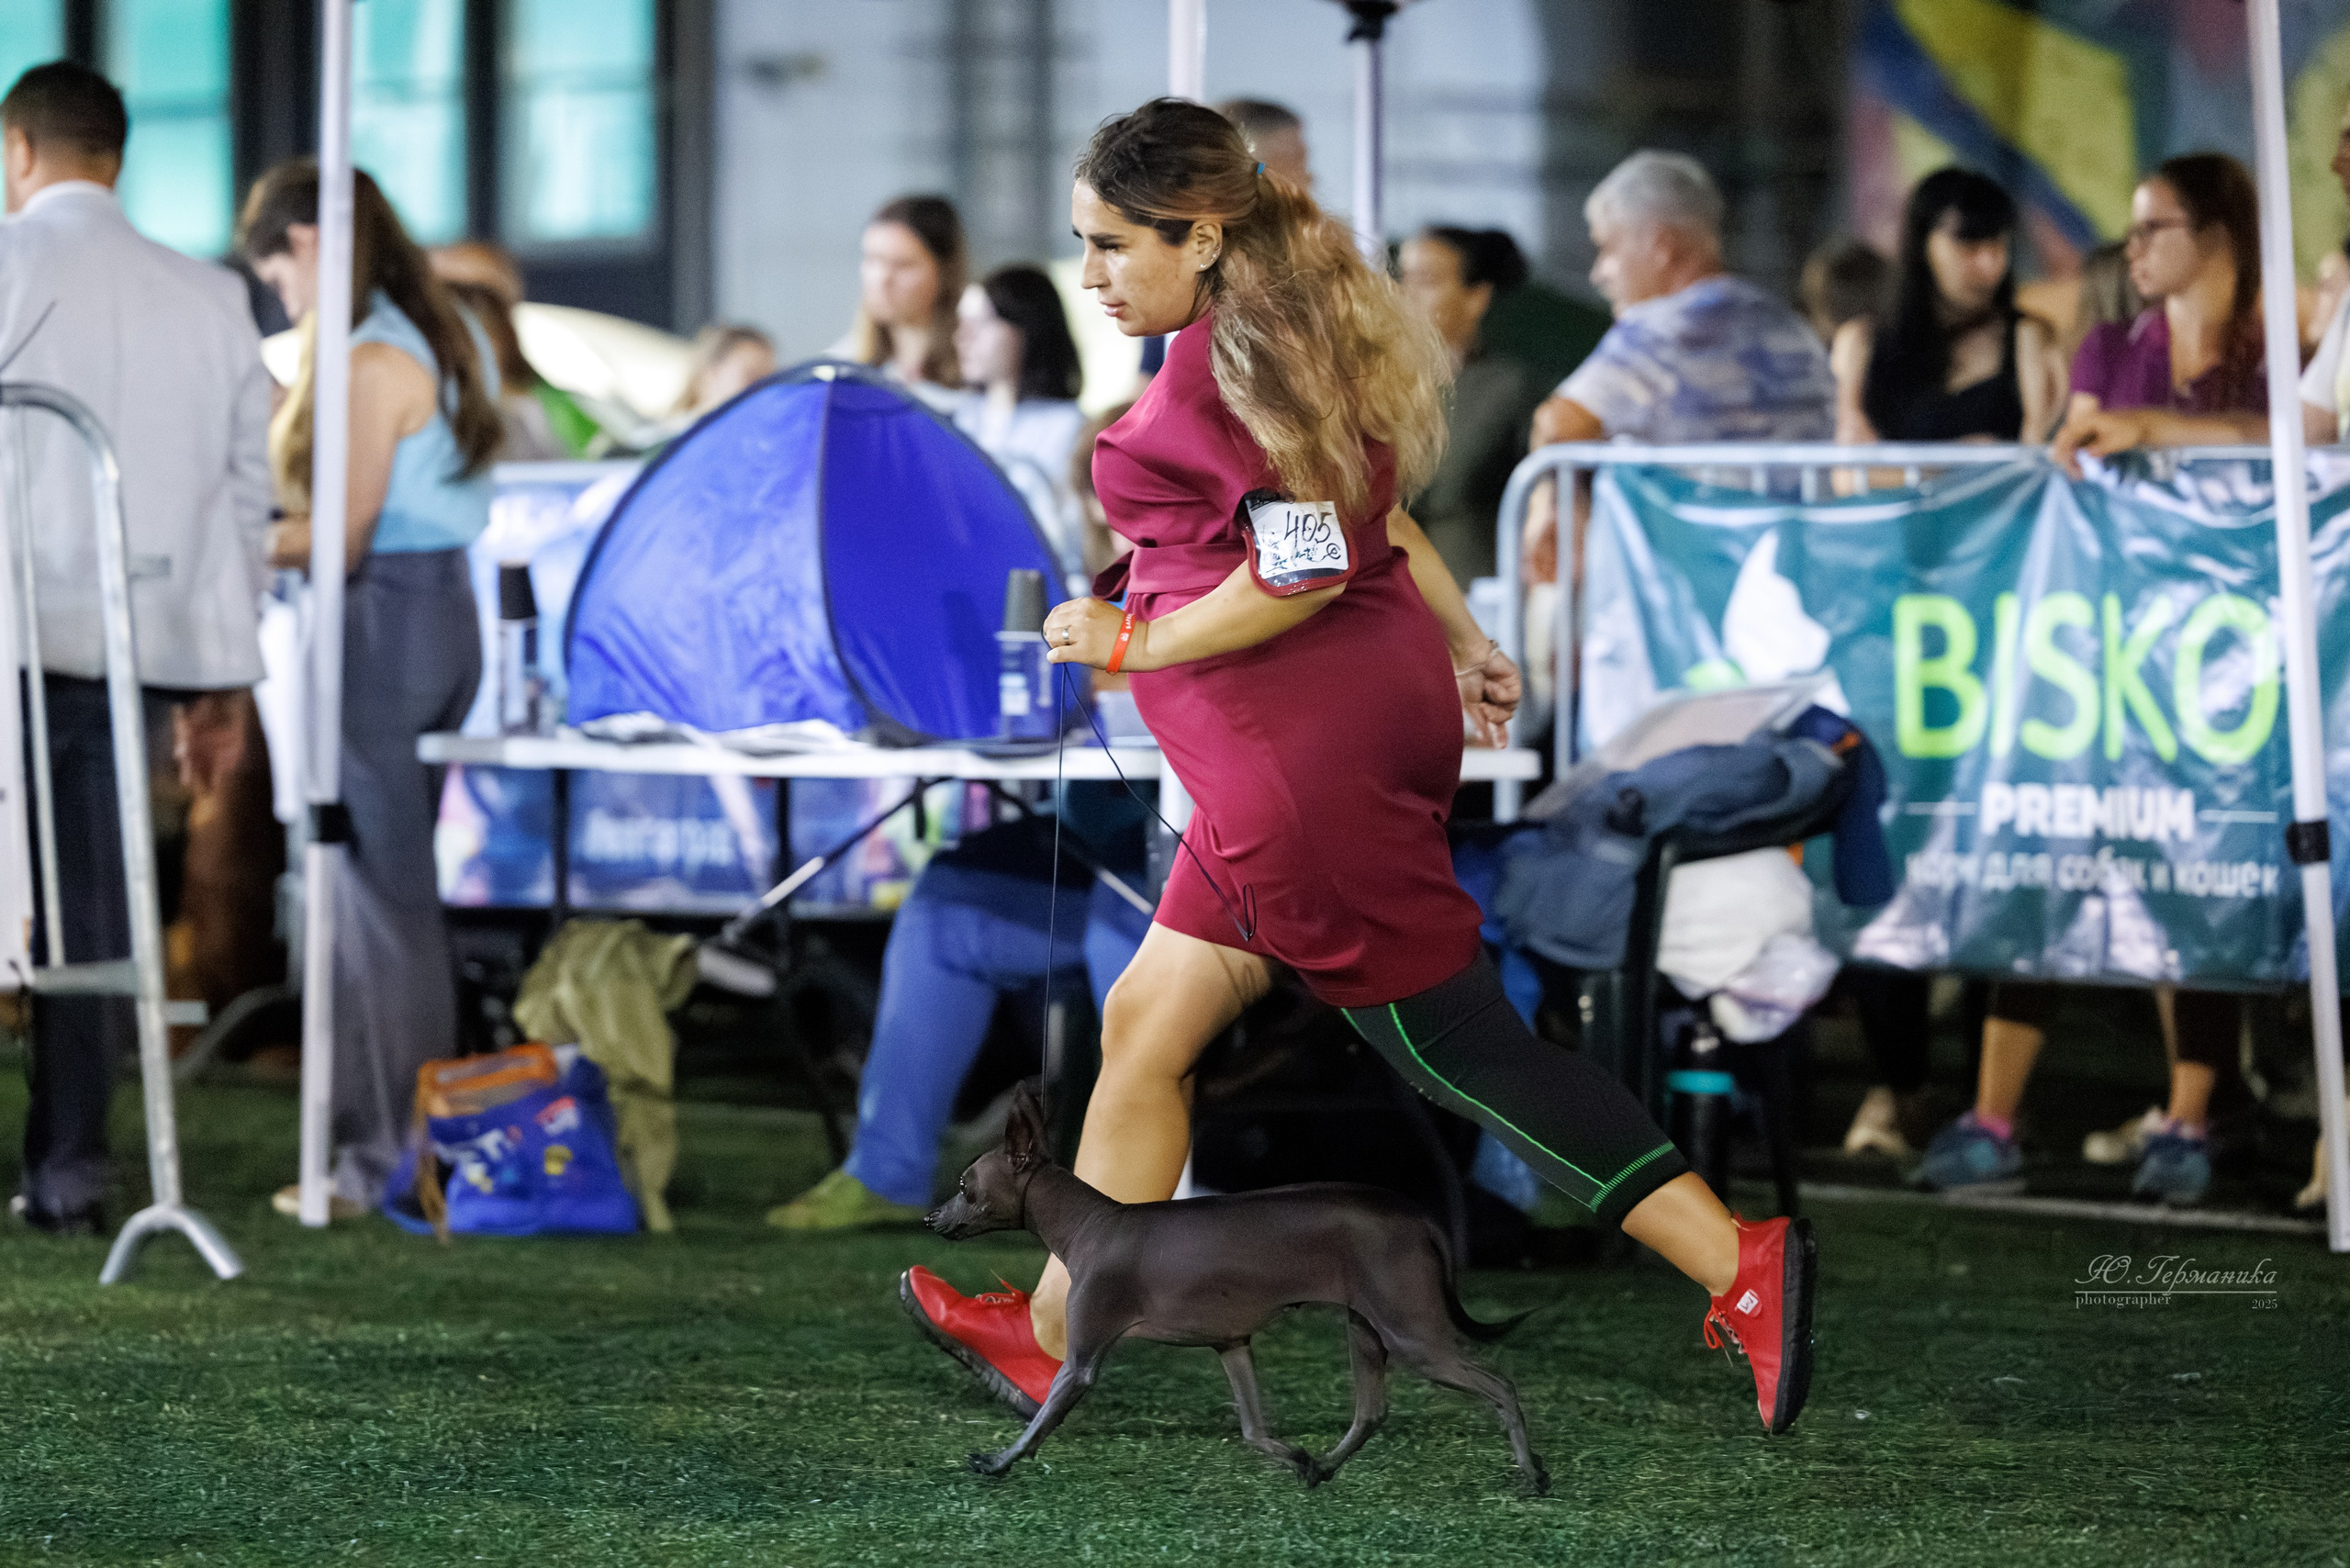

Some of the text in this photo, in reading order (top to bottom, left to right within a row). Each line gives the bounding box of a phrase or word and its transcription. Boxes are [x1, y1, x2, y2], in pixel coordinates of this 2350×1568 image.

[1284, 510, 1332, 547] 405
[1894, 592, 2278, 765] BISKO
[1981, 782, 2195, 841] PREMIUM
[2150, 861, 2171, 893] и
[2174, 861, 2279, 897] кошек
